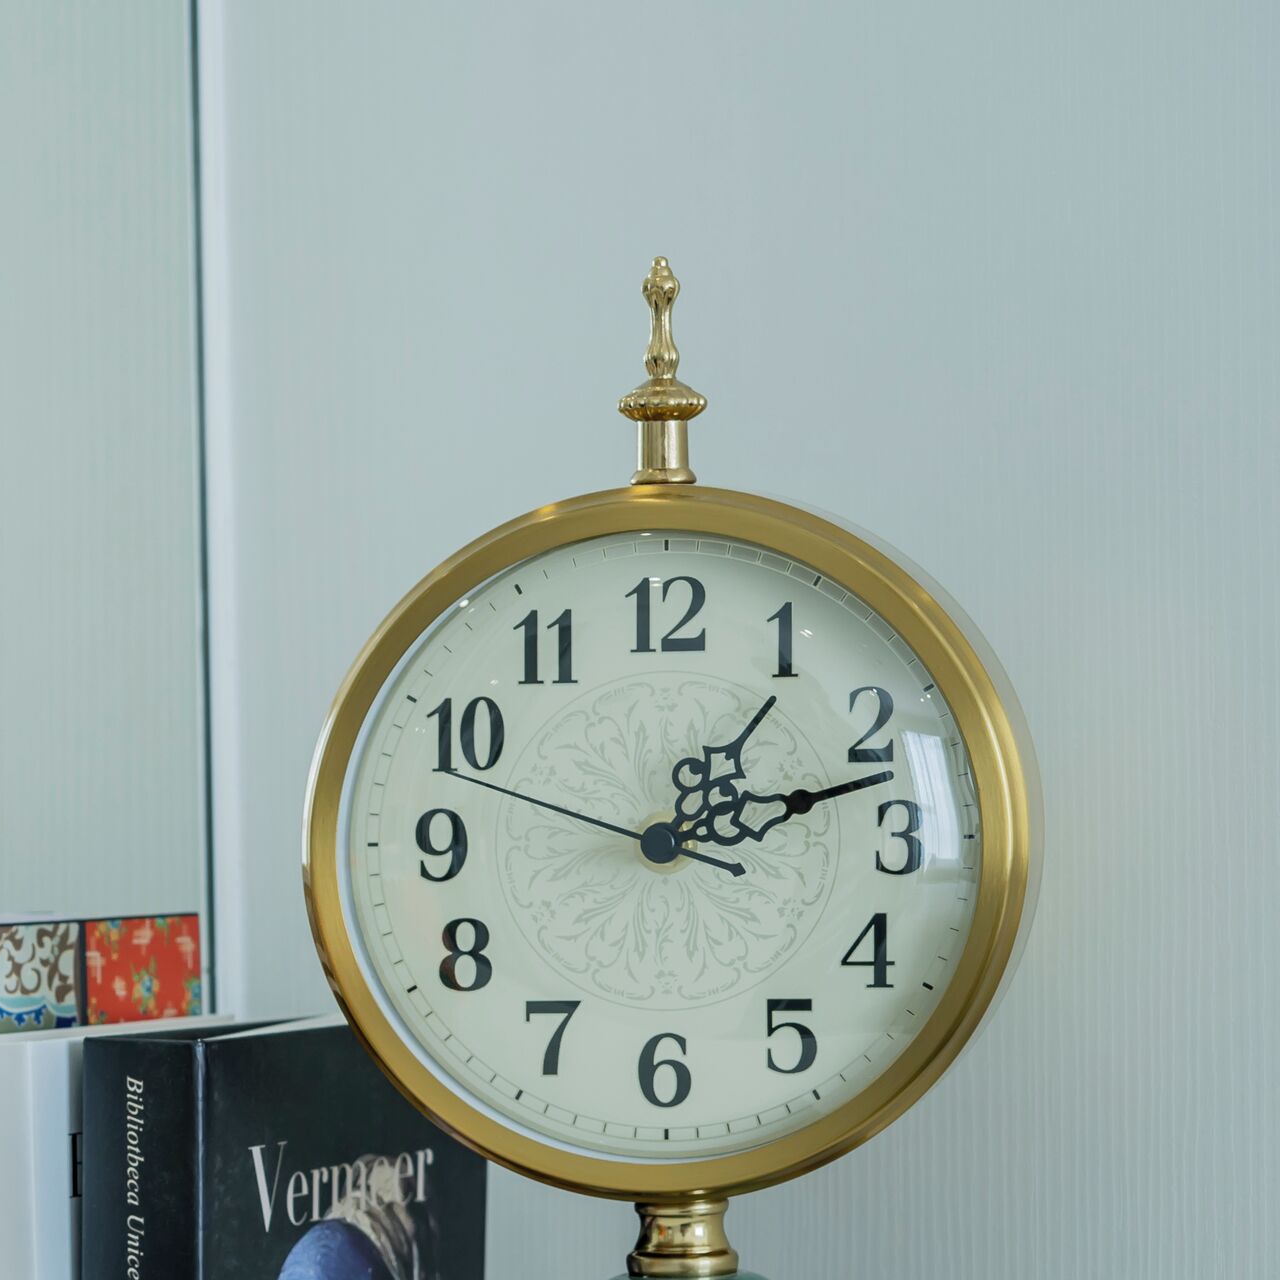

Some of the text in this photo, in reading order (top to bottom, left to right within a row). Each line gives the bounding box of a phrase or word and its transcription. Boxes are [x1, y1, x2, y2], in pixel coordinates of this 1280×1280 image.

[513, 609, 578, 685] 11
[625, 576, 706, 653] 12
[766, 602, 799, 678] 1
[426, 697, 505, 773] 10
[848, 686, 894, 763] 2
[415, 808, 469, 882] 9
[875, 800, 922, 875] 3
[439, 918, 493, 991] 8
[841, 913, 895, 988] 4
[524, 1000, 581, 1076] 7
[638, 1033, 691, 1108] 6
[766, 999, 818, 1074] 5
[248, 1140, 434, 1233] Vermeer
